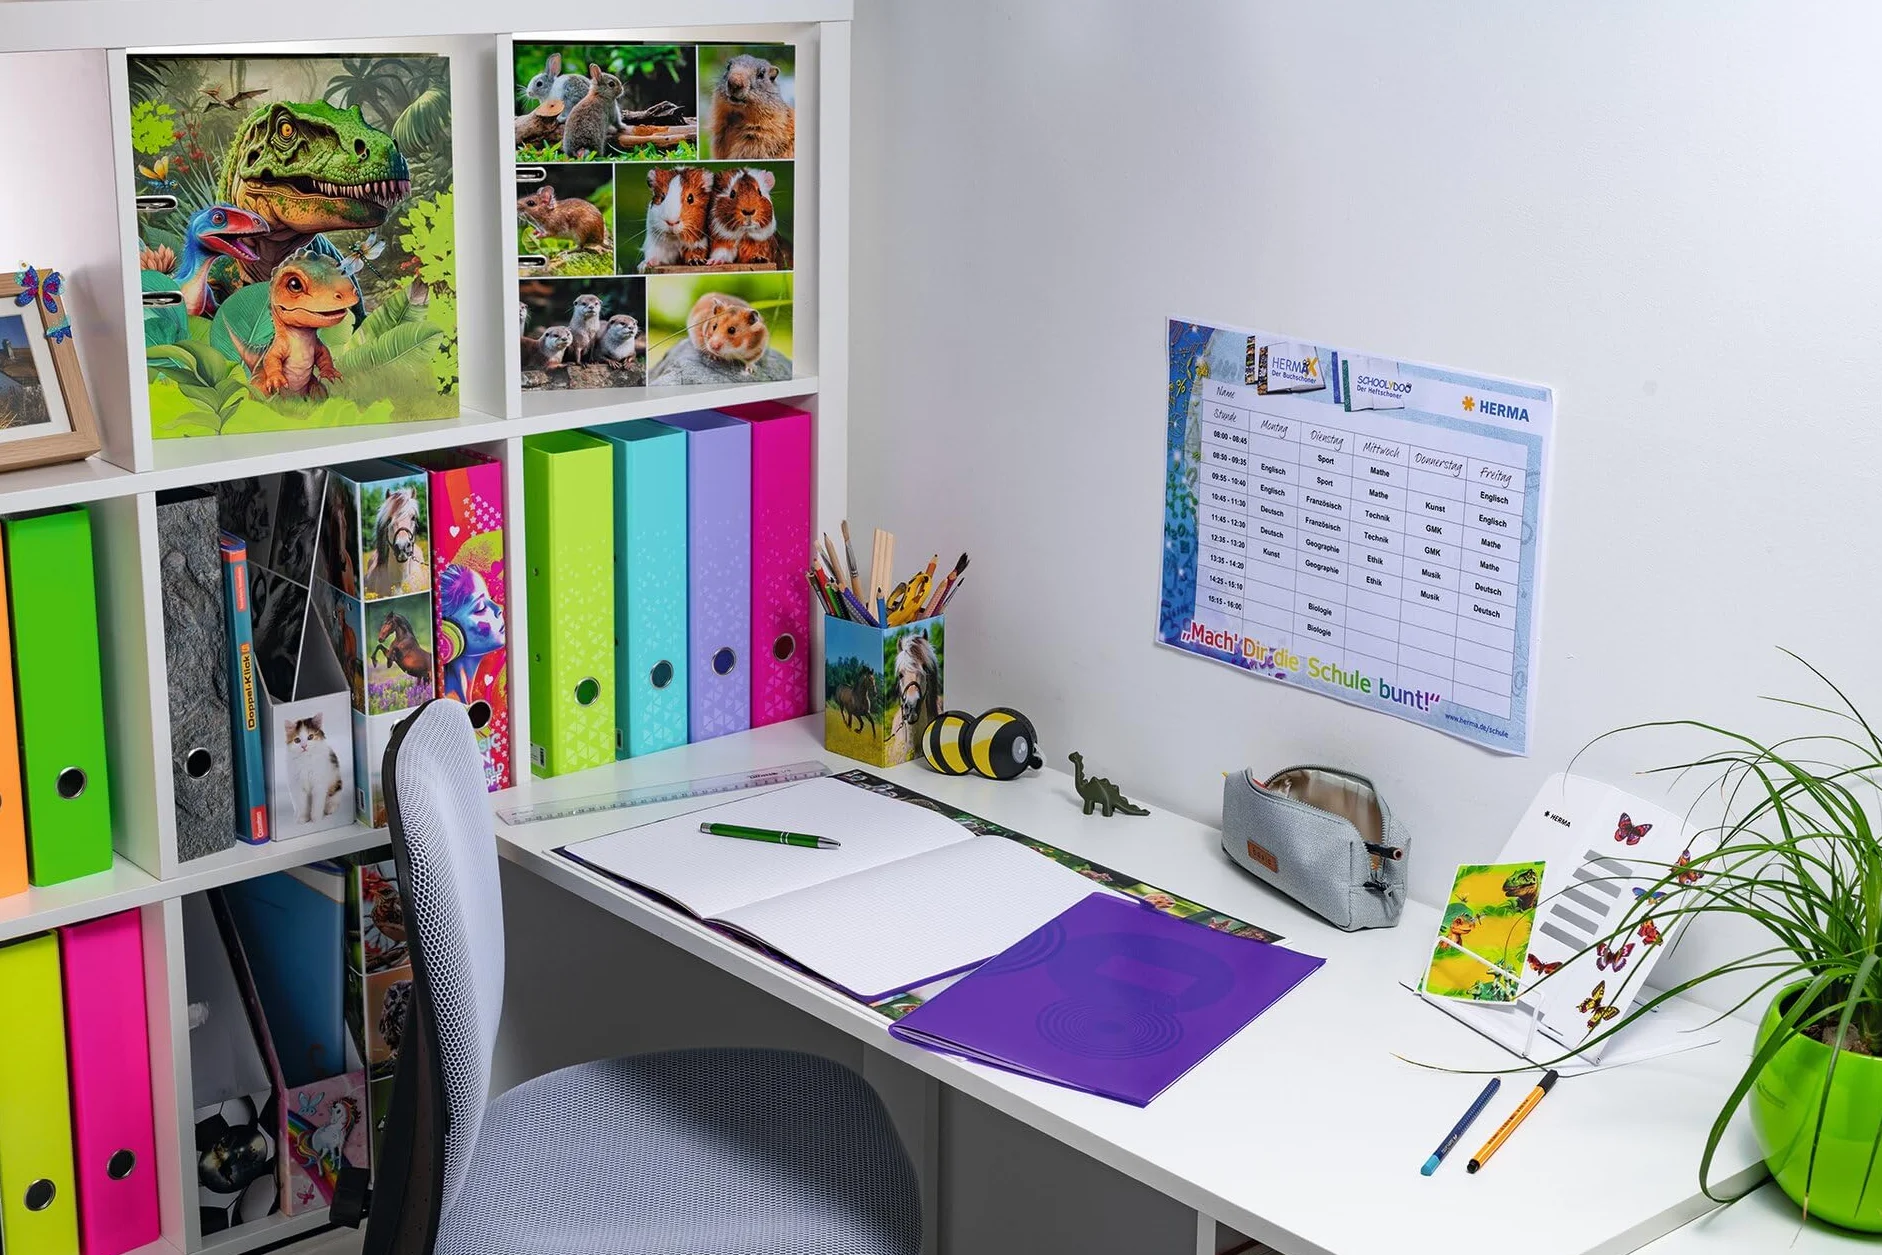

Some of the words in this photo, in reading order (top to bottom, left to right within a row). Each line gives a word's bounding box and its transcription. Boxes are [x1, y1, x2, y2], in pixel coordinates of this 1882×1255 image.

[1216, 386, 1236, 400] Name
[1368, 387, 1402, 399] Heftschoner
[1214, 408, 1238, 423] Stunde
[1480, 400, 1530, 422] HERMA
[1260, 420, 1289, 440] Montag
[1213, 430, 1229, 440] 08:00
[1233, 435, 1248, 445] 08:45
[1310, 430, 1344, 452] Dienstag
[1363, 442, 1399, 459] Mittwoch
[1213, 451, 1228, 461] 08:50
[1232, 456, 1247, 466] 09:35
[1317, 454, 1334, 466] Sport
[1414, 452, 1463, 478] Donnerstag
[1261, 463, 1286, 476] Englisch
[1370, 466, 1390, 478] Mathe
[1212, 472, 1227, 482] 09:55
[1232, 477, 1246, 487] 10:40
[1317, 476, 1333, 487] Sport
[1480, 467, 1513, 489] Freitag
[1260, 484, 1286, 497] Englisch
[1369, 489, 1389, 500] Mathe
[1212, 493, 1227, 503] 10:45
[1231, 498, 1246, 508] 11:30
[1306, 495, 1342, 511] Französisch
[1480, 491, 1509, 505] Englisch
[1260, 505, 1284, 518] Deutsch
[1425, 501, 1446, 513] Kunst
[1211, 513, 1227, 524] 11:45
[1231, 518, 1246, 528] 12:30
[1365, 510, 1390, 523] Technik
[1479, 514, 1507, 528] Englisch
[1305, 516, 1341, 532] Französisch
[1425, 524, 1442, 535] GMK
[1260, 526, 1284, 539] Deutsch
[1364, 531, 1389, 544] Technik
[1211, 534, 1226, 544] 12:35
[1231, 539, 1245, 549] 13:20
[1305, 538, 1340, 554] Geographie
[1481, 538, 1501, 550] Mathe
[1263, 547, 1280, 559] Kunst
[1424, 546, 1441, 557] GMK
[1210, 554, 1225, 564] 13:35
[1230, 559, 1244, 569] 14:20
[1305, 559, 1340, 575] Geographie
[1367, 554, 1384, 566] Ethik
[1479, 560, 1500, 573] Mathe
[1421, 568, 1441, 580] Musik
[1209, 575, 1224, 585] 14:25
[1229, 581, 1243, 591] 15:10
[1366, 576, 1383, 587] Ethik
[1420, 590, 1440, 601] Musik
[1475, 582, 1502, 596] Deutsch
[1208, 595, 1224, 605] 15:15
[1227, 601, 1242, 611] 16:00
[1308, 602, 1332, 617] Biologie
[1473, 604, 1501, 618] Deutsch
[1307, 623, 1332, 637] Biologie
[1244, 637, 1268, 659] Dir
[1274, 648, 1299, 672] die
[1308, 656, 1371, 694] Schule
[1445, 713, 1509, 738] www.herma.de/schule
[1550, 814, 1571, 827] HERMA
